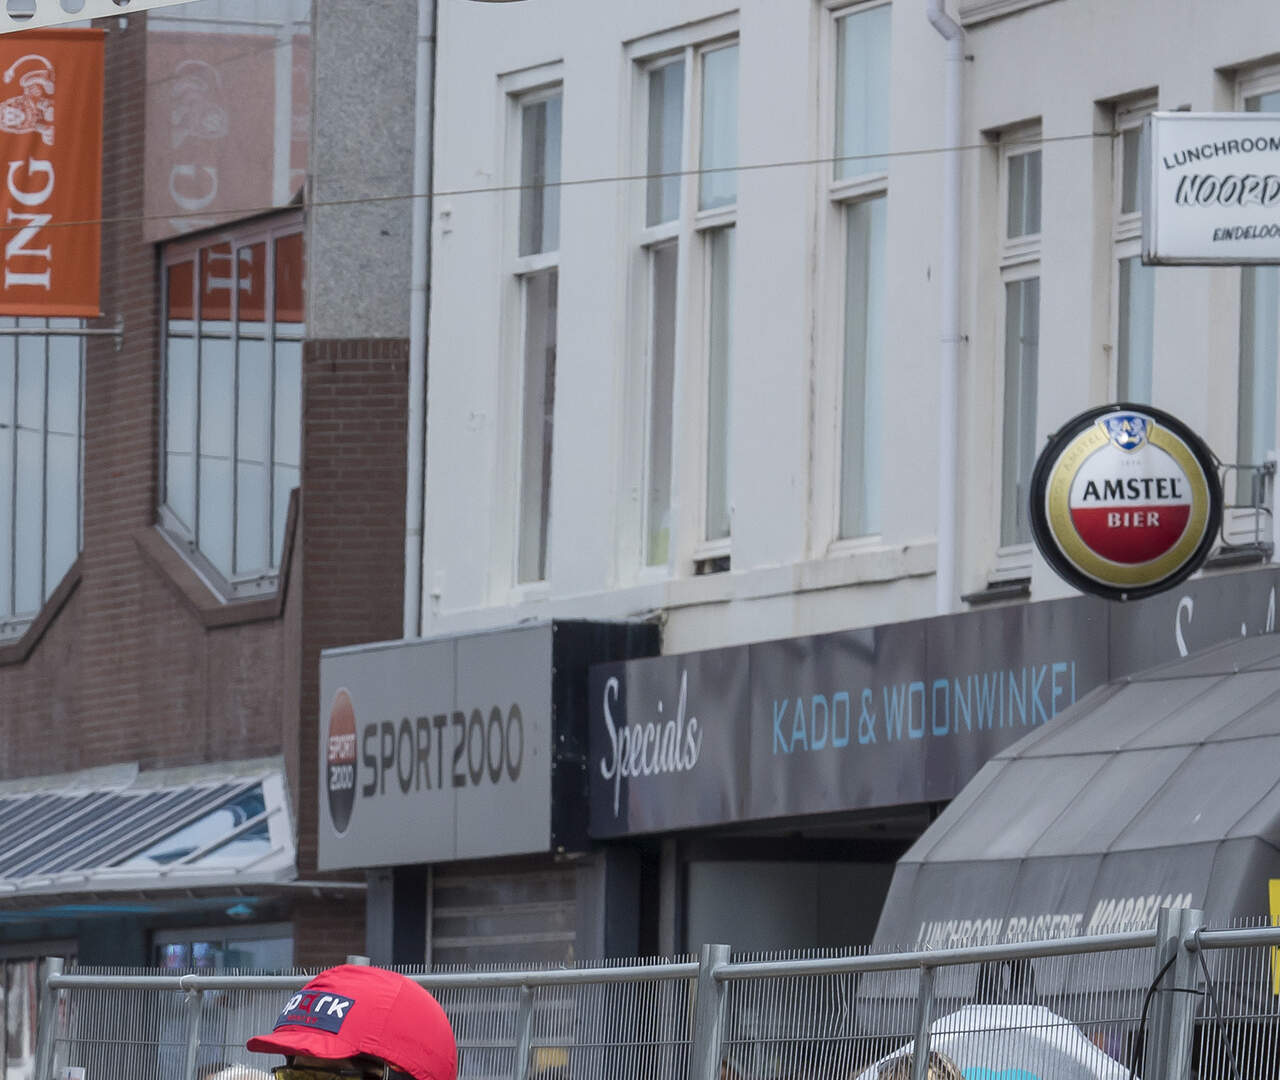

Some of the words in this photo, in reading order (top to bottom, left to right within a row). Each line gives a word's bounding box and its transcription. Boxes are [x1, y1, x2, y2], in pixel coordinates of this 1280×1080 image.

[4, 156, 55, 292] ING
[1083, 478, 1182, 501] AMSTEL
[1108, 511, 1160, 528] BIER
[600, 669, 703, 818] Specials
[773, 690, 849, 755] KADO
[858, 687, 877, 745] &
